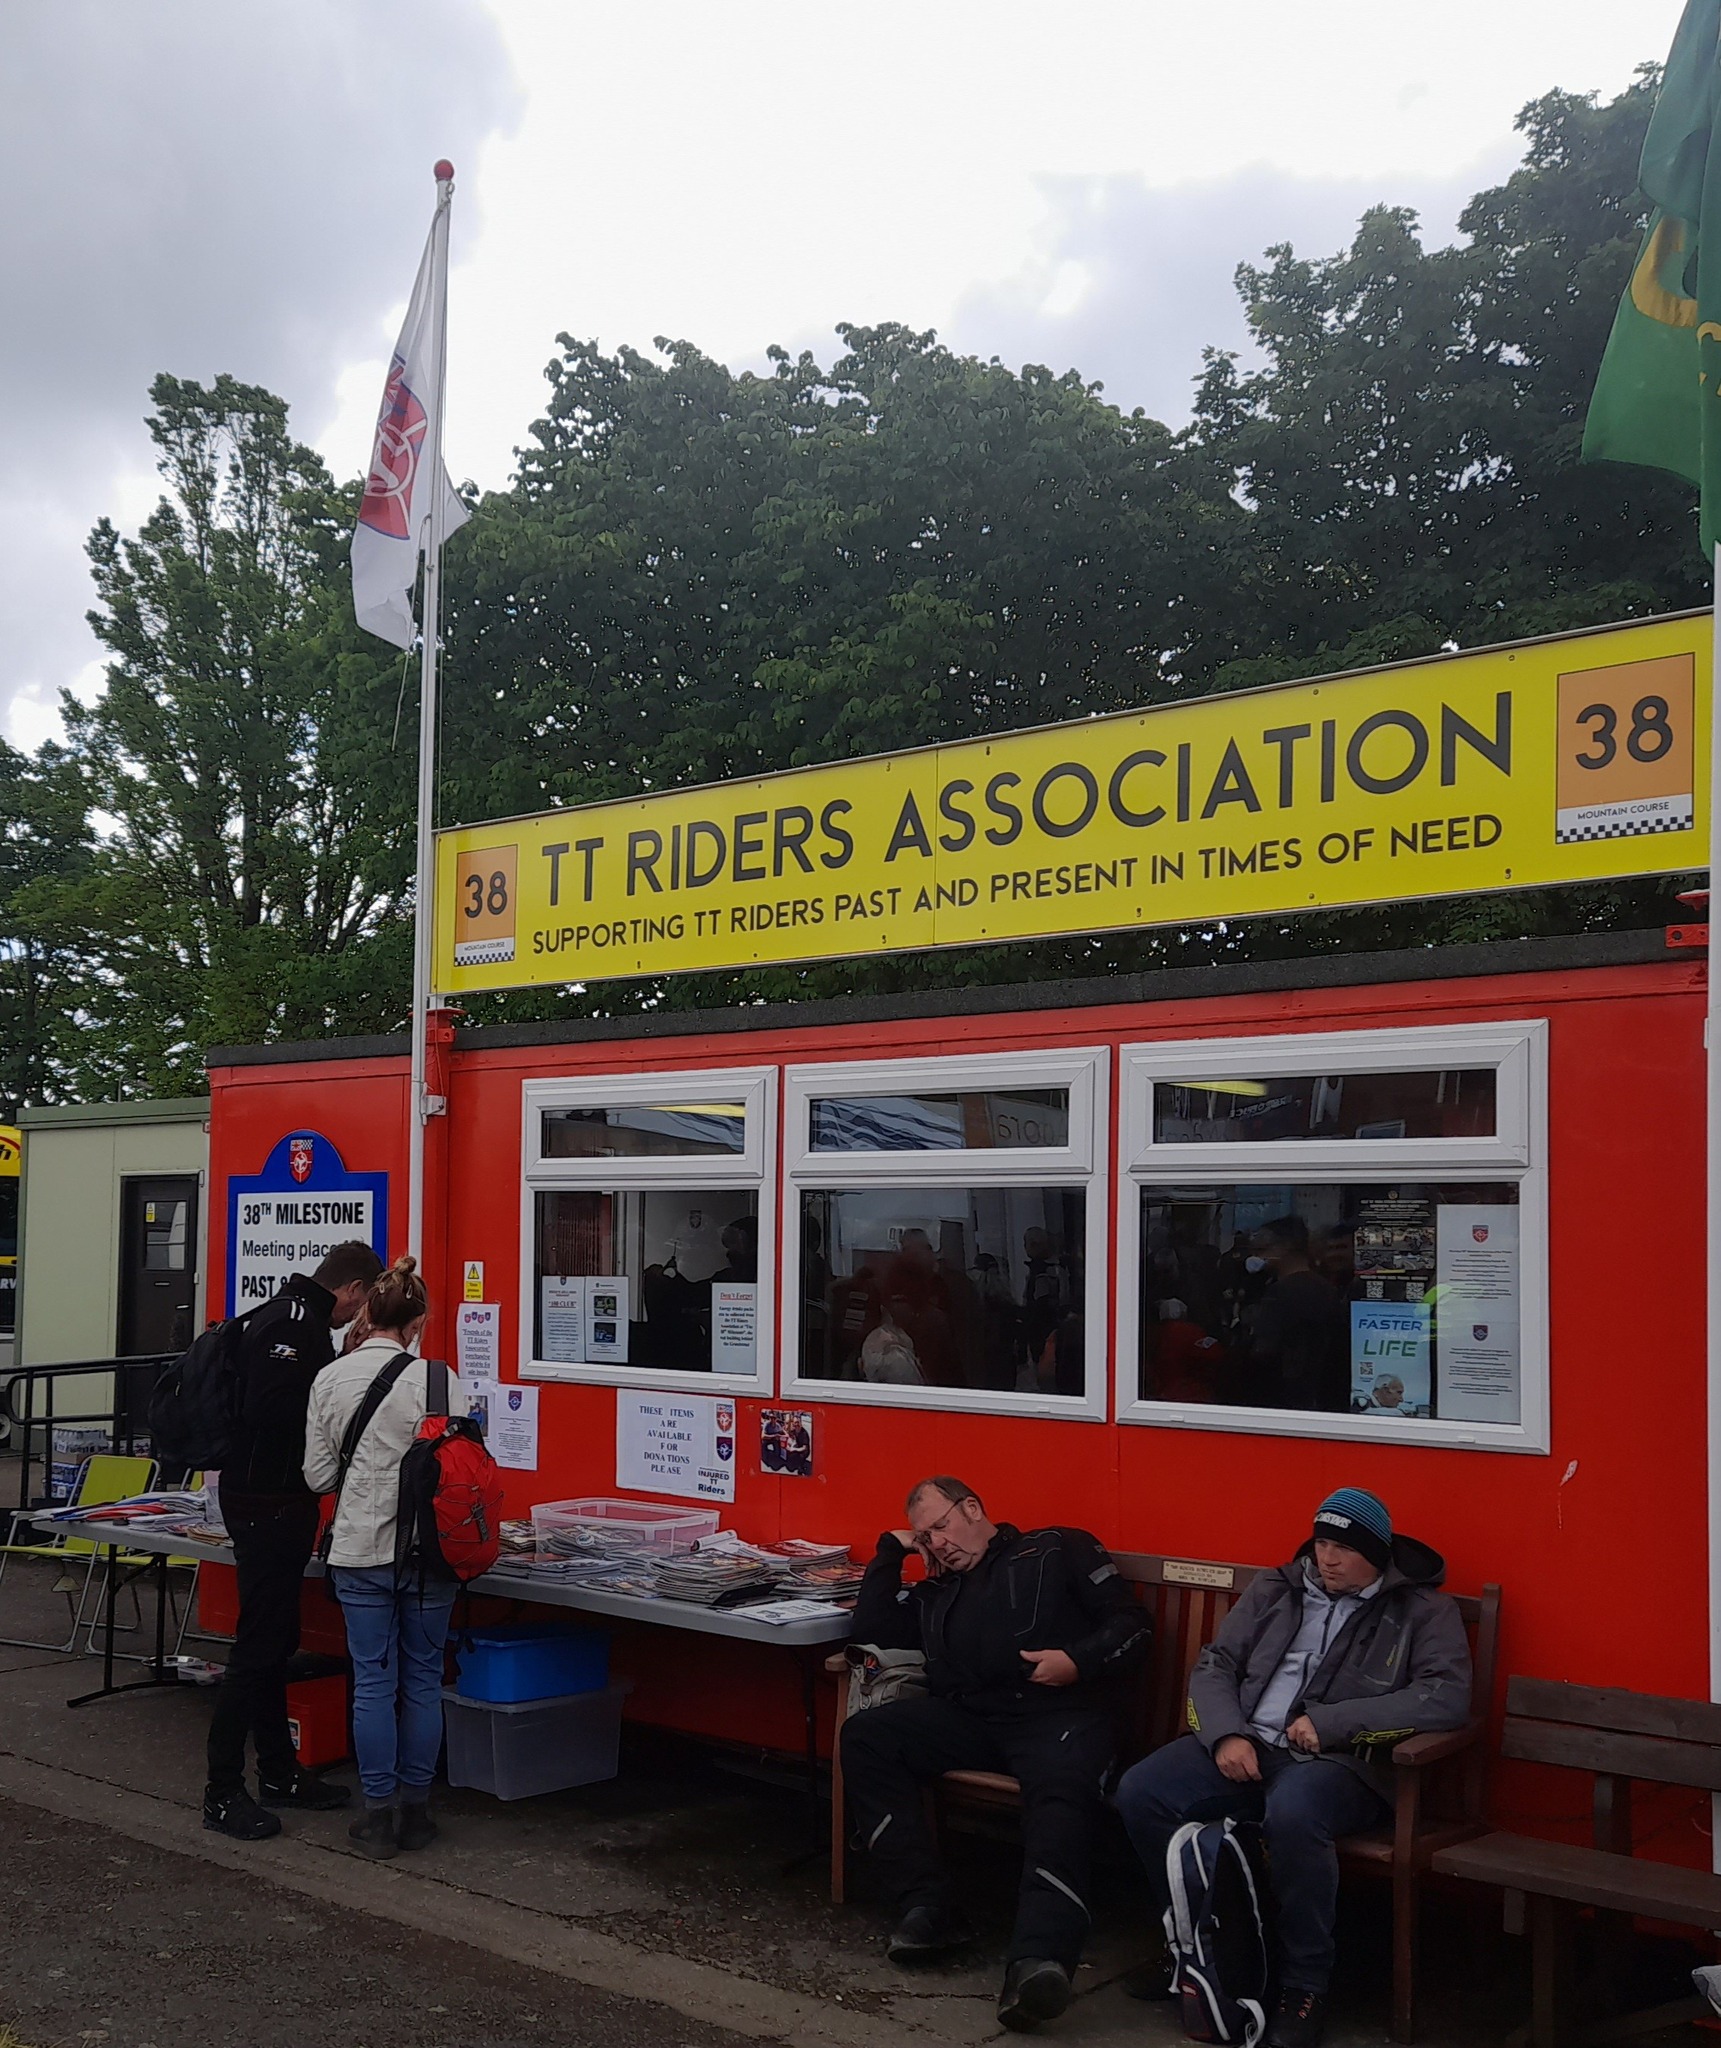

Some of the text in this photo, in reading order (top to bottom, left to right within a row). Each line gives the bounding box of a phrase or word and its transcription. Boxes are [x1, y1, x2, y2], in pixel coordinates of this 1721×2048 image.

[1575, 695, 1674, 770] 38
[542, 691, 1512, 906] TT RIDERS ASSOCIATION
[1577, 801, 1670, 820] MOUNTAIN COURSE
[532, 814, 1502, 955] SUPPORTING TT RIDERS PAST AND PRESENT IN TIMES OF NEED
[463, 870, 508, 919] 38
[243, 1202, 364, 1225] 38TH MILESTONE
[242, 1240, 295, 1261] Meeting
[241, 1276, 276, 1298] PAST
[1358, 1318, 1423, 1331] FASTER
[1363, 1339, 1418, 1357] LIFE
[639, 1405, 694, 1418] THESE ITEMS
[647, 1430, 692, 1441] AVAILABLE
[644, 1452, 690, 1464] DONATIONS
[651, 1464, 681, 1475] PLEASE
[698, 1471, 730, 1481] INJURED
[698, 1483, 726, 1495] Riders
